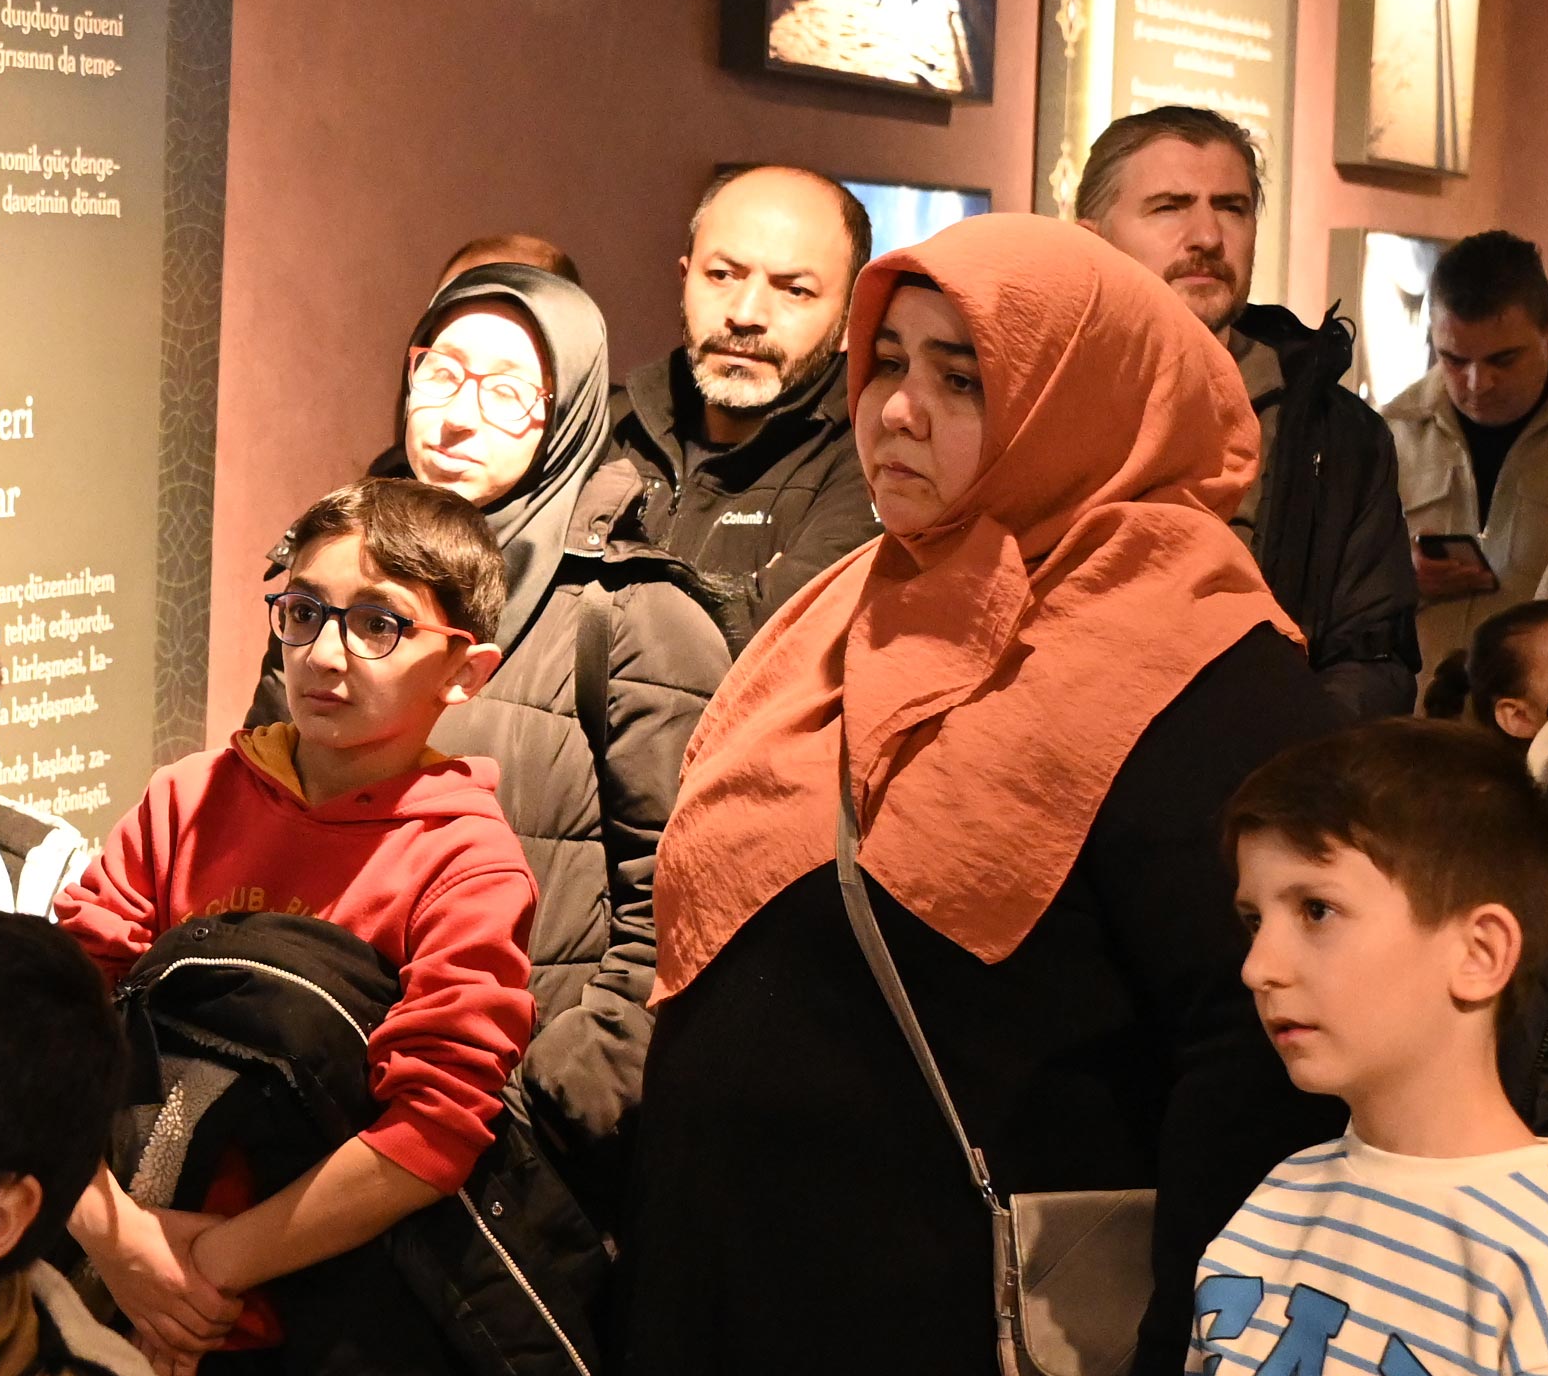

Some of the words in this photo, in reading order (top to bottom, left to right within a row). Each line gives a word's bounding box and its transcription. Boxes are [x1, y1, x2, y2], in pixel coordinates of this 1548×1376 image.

[74, 11, 123, 39] güveni
[58, 46, 76, 74] da
[80, 54, 122, 78] teme-
[43, 150, 69, 180] güç
[71, 147, 120, 182] denge-
[2, 185, 68, 215] davetinin
[71, 188, 120, 218] dönüm
[25, 572, 84, 603] düzenini
[85, 567, 115, 596] hem
[5, 614, 46, 645] tehdit
[49, 605, 114, 642] ediyordu.
[12, 650, 86, 685] birleşmesi,
[90, 645, 113, 671] ka-
[12, 685, 99, 728] bağdaşmadı.
[53, 782, 111, 815] dönüştü.
